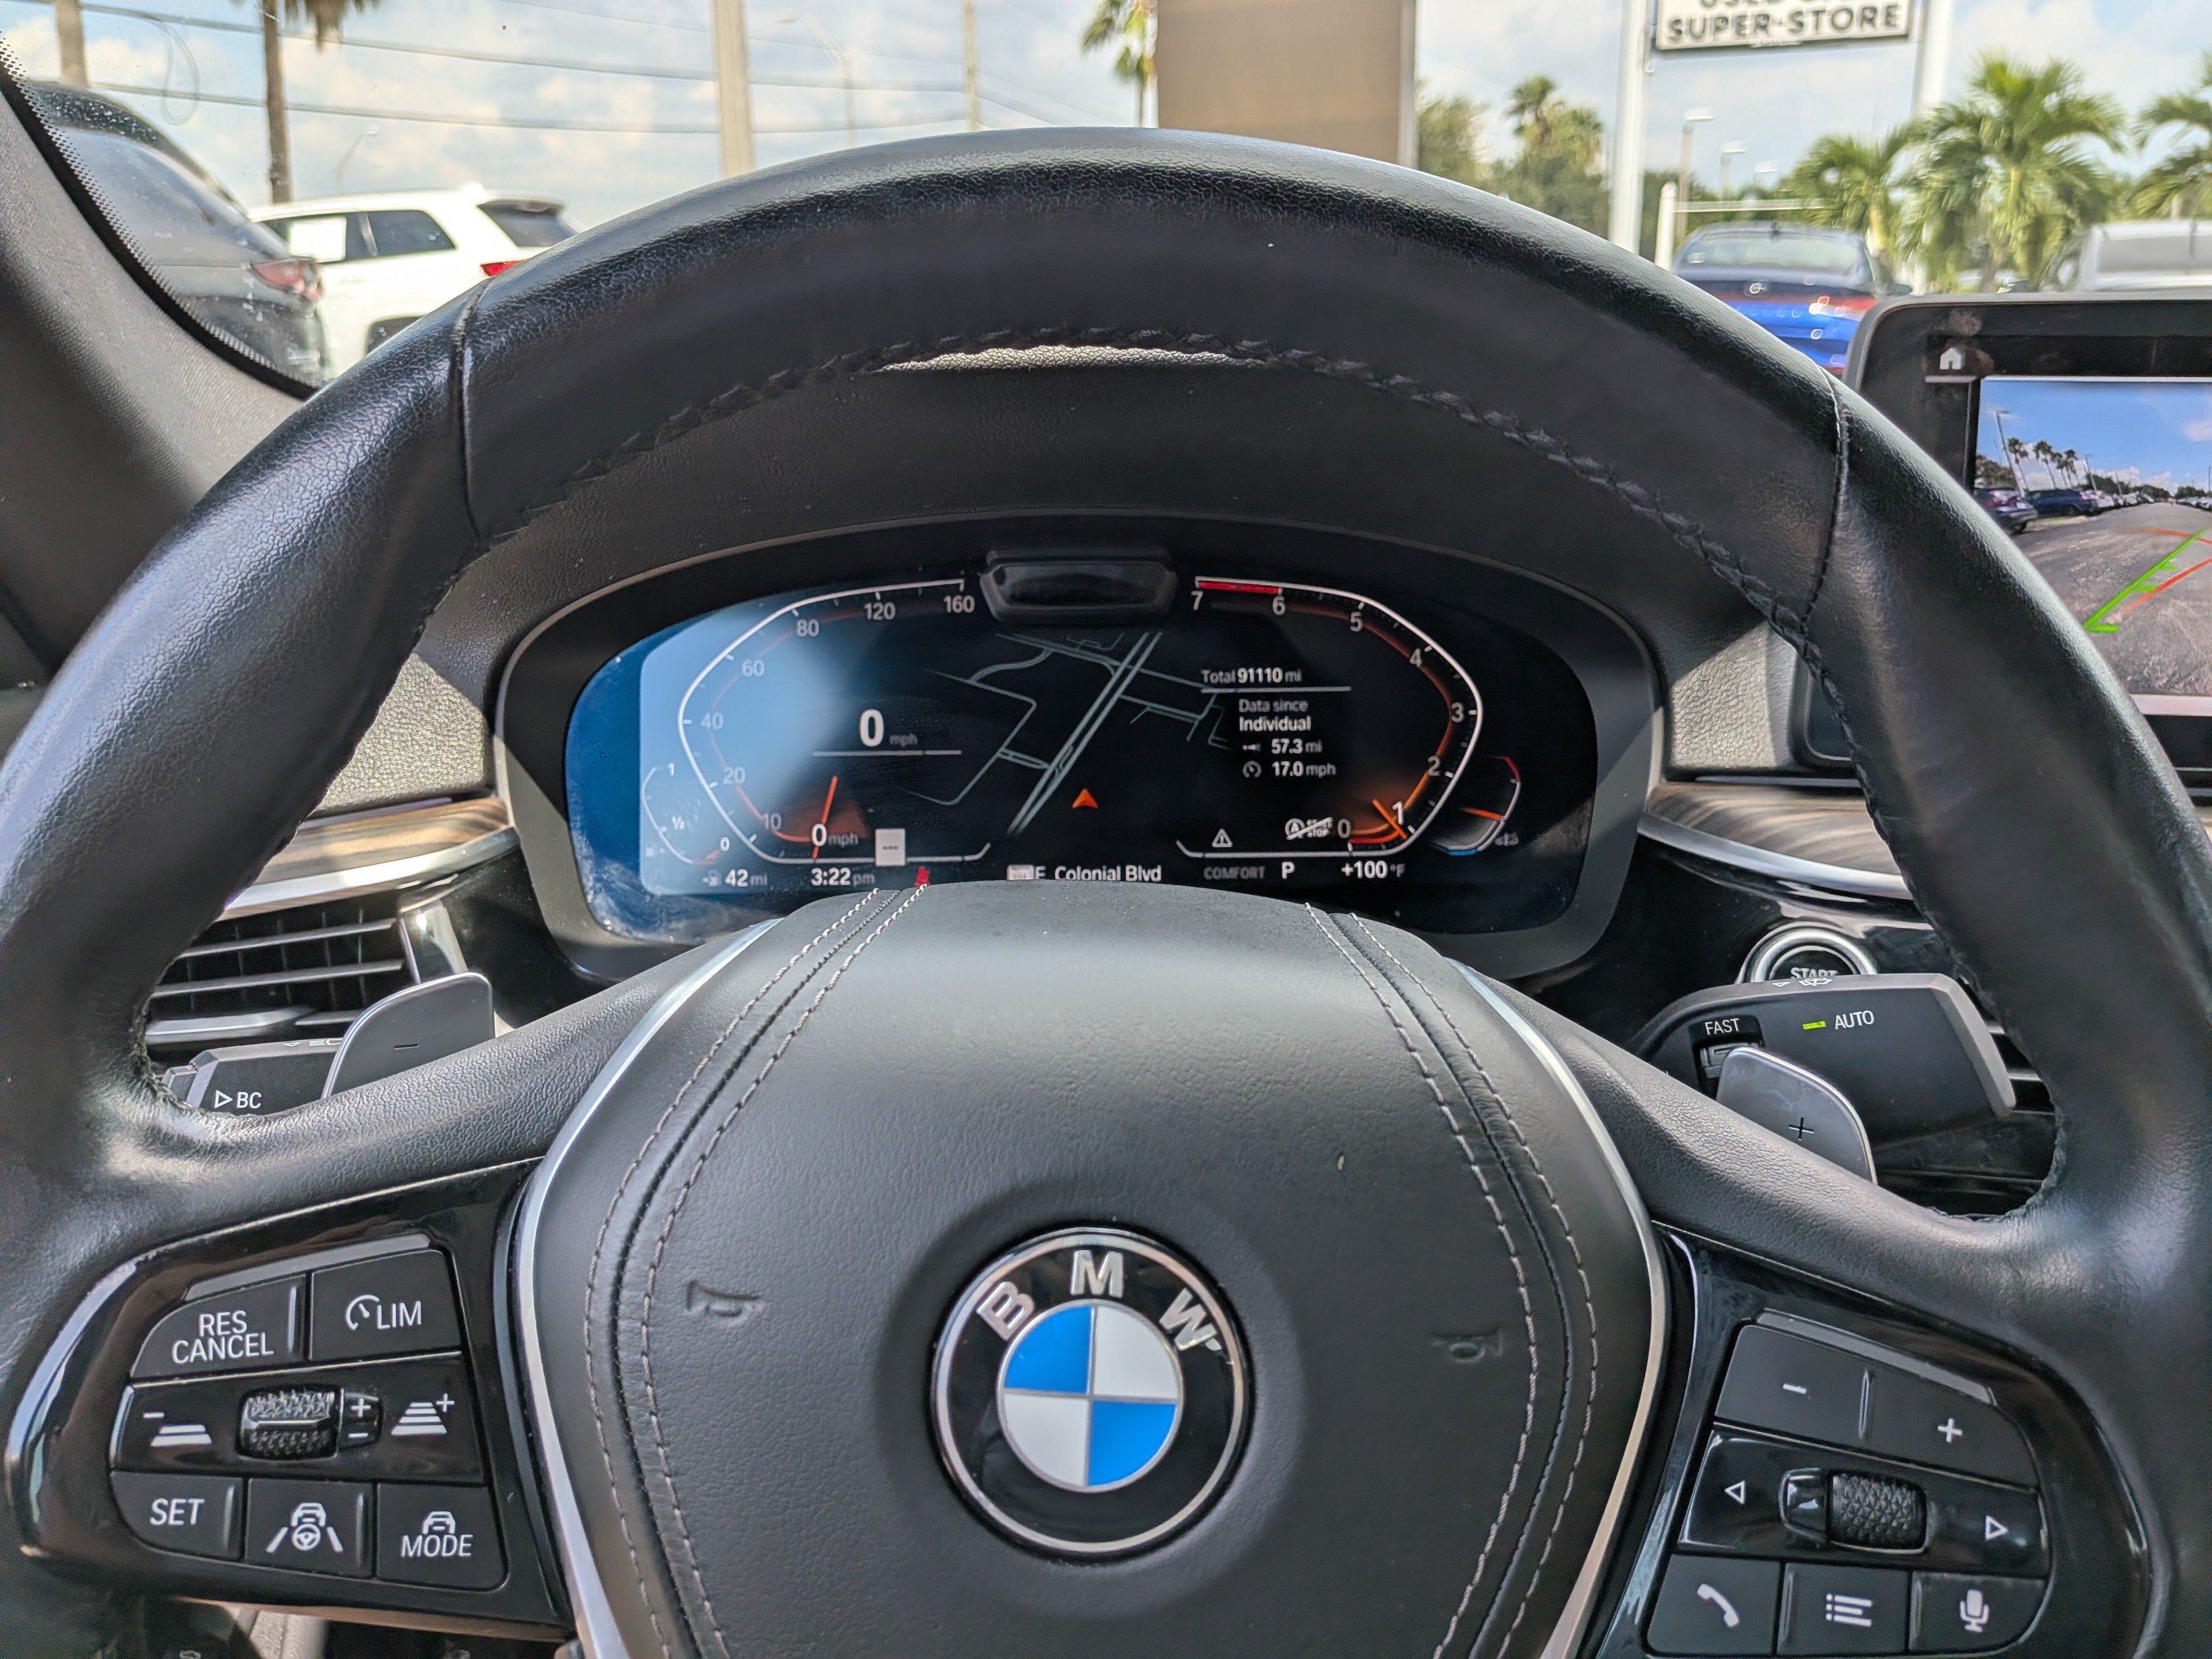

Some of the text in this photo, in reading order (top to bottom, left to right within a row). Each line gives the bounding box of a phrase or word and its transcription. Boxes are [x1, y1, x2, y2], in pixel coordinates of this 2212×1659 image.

[1668, 4, 1899, 41] SUPER-STORE
[943, 595, 975, 613] 160
[1191, 590, 1203, 611] 7
[1273, 596, 1286, 615] 6
[863, 602, 896, 620] 120
[795, 619, 820, 637] 80
[1350, 612, 1363, 632] 5
[1410, 648, 1422, 667] 4
[742, 660, 764, 677] 60
[1201, 667, 1302, 684] Total 91110 mi
[1239, 698, 1309, 713] Data since
[1452, 702, 1465, 723] 3
[701, 712, 724, 729] 40
[859, 709, 918, 747] 0 mph
[1239, 715, 1312, 732] Individual
[1271, 738, 1323, 754] 57.3 mi
[668, 763, 675, 776] 1
[1272, 760, 1337, 779] 17.0 mph
[1428, 755, 1440, 776] 2
[723, 767, 746, 785] 20
[763, 812, 782, 830] 10
[1392, 801, 1404, 825] 1
[811, 823, 859, 848] 0 mph
[1337, 818, 1352, 839] 0
[720, 837, 730, 852] 0
[725, 869, 768, 887] 42 mi
[811, 867, 875, 886] 3:22 pm
[1055, 865, 1121, 881] Colonial
[1126, 864, 1161, 883] Blvd
[1204, 866, 1265, 880] COMFORT
[1281, 862, 1296, 879] P
[1705, 1018, 1740, 1036] FAST
[1834, 1010, 1875, 1030] AUTO
[237, 1092, 262, 1109] BC
[977, 1250, 1219, 1351] BMW
[198, 1310, 248, 1337] RES
[378, 1301, 422, 1330] LIM
[172, 1333, 274, 1365] CANCEL
[150, 1498, 205, 1526] SET
[400, 1534, 473, 1559] MODE
